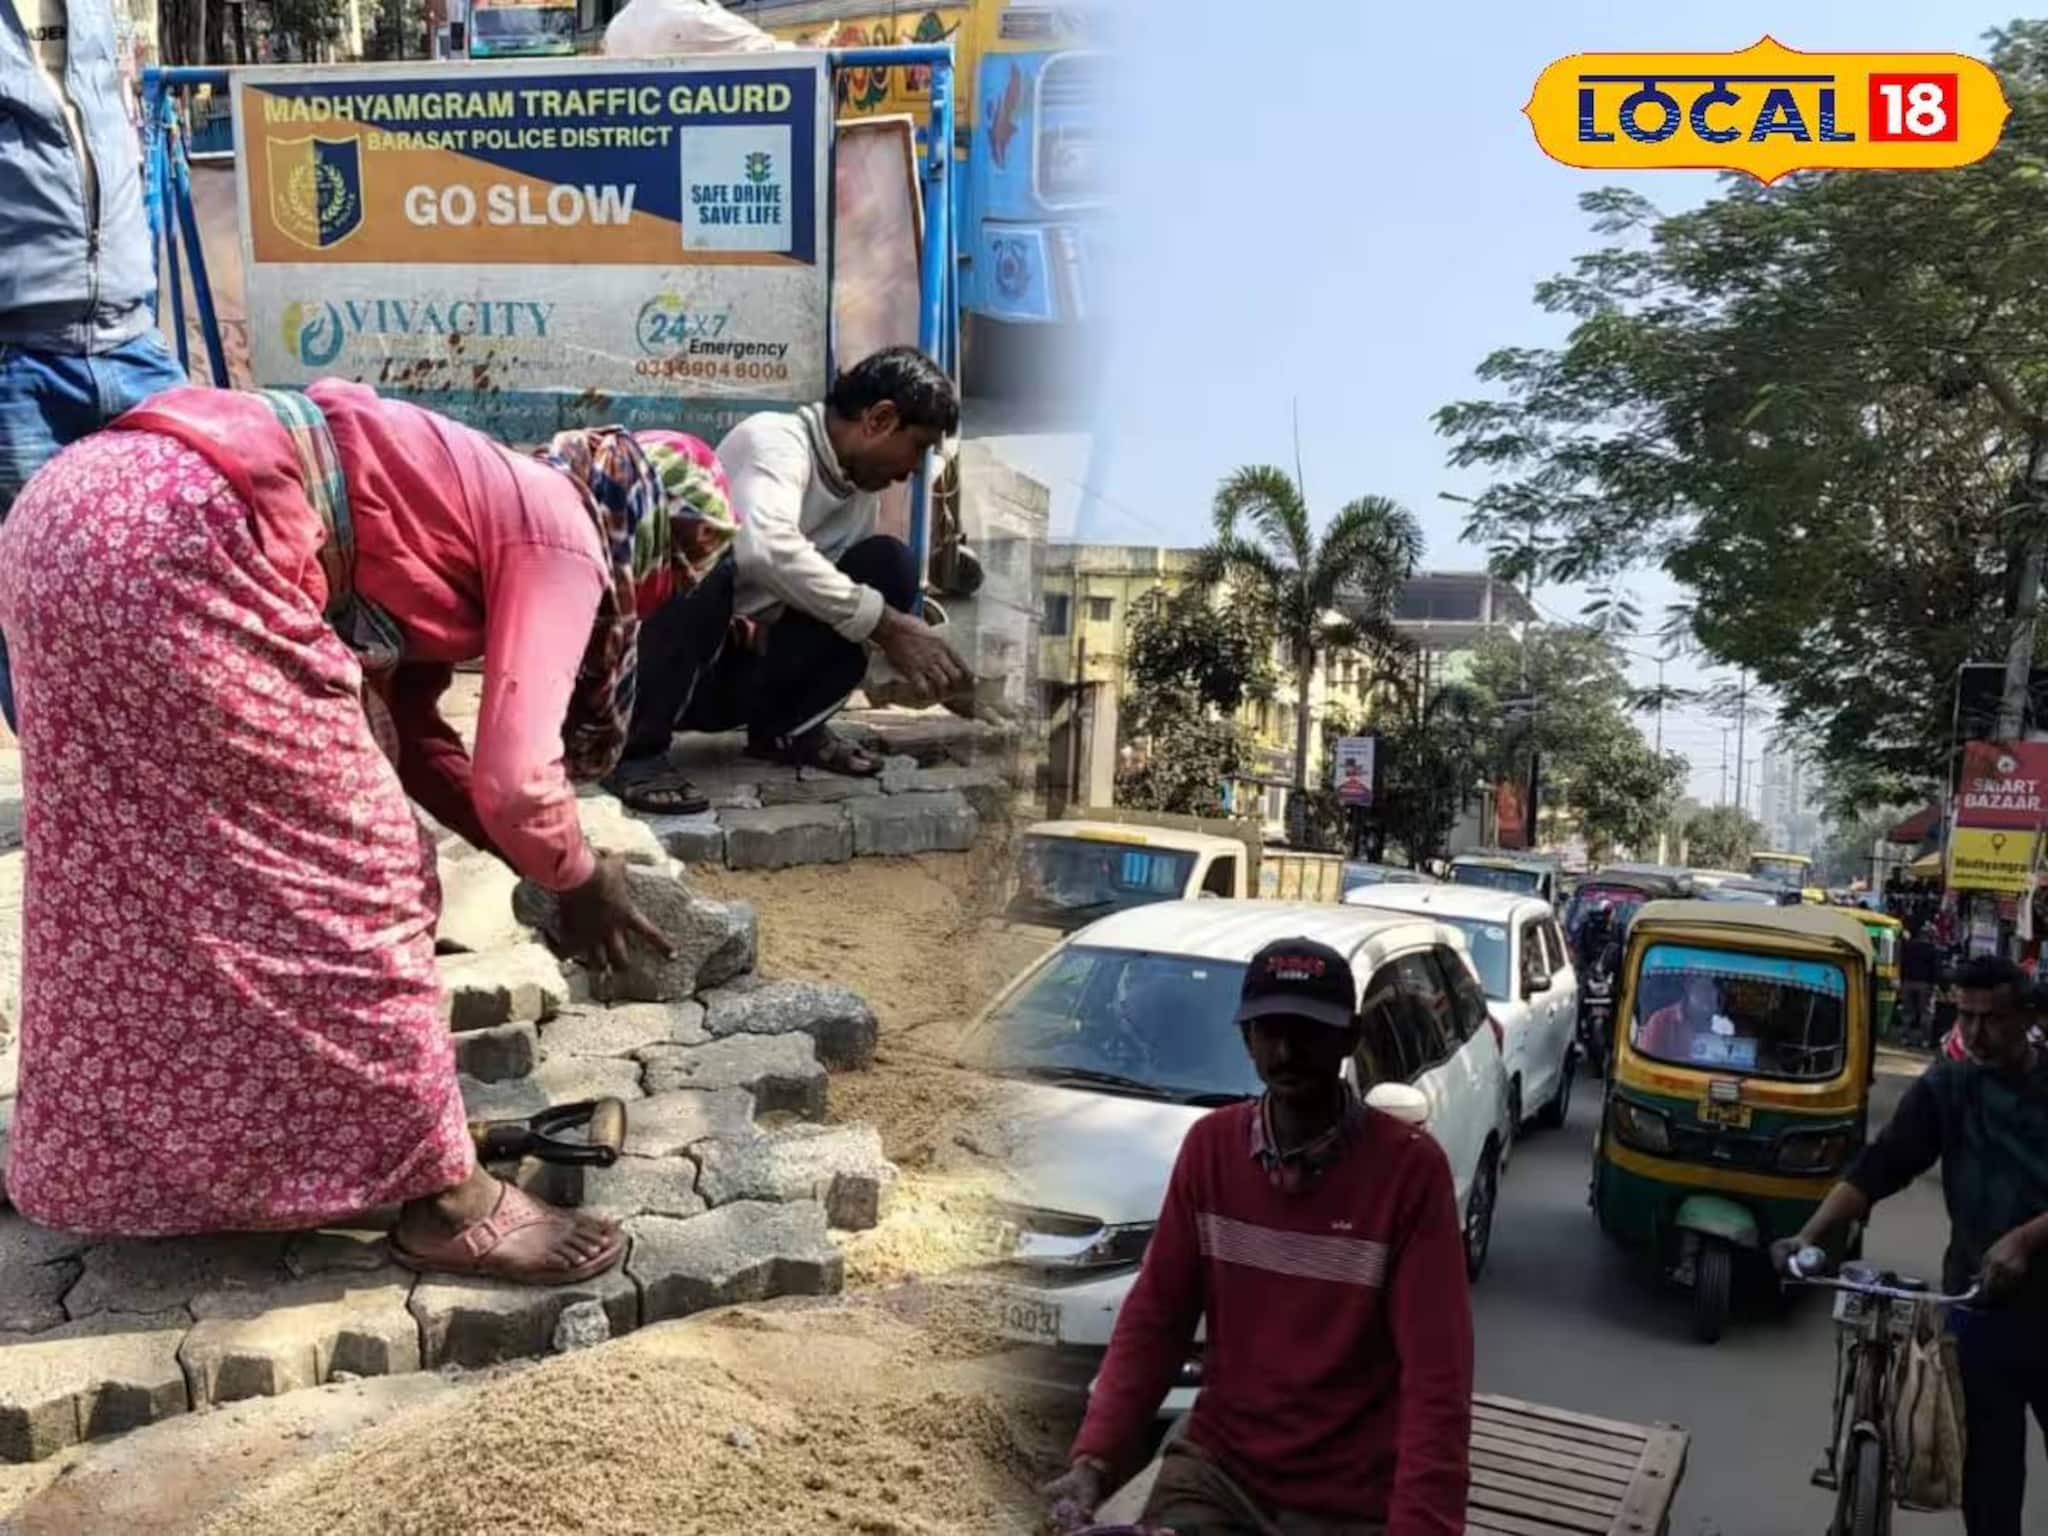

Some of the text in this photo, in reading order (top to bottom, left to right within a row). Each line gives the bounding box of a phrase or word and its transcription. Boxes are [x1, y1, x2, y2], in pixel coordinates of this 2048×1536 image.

[264, 83, 792, 122] MADHYAMGRAM TRAFFIC GAURD
[367, 126, 673, 151] BARASAT POLICE DISTRICT
[404, 184, 477, 227] GO
[486, 183, 637, 227] SLOW
[691, 184, 782, 204] SAFE DRIVE
[699, 205, 782, 224] SAVE LIFE
[345, 299, 556, 337] VIVACITY
[689, 338, 789, 361] Emergency
[1964, 793, 2042, 812] BAZAAR
